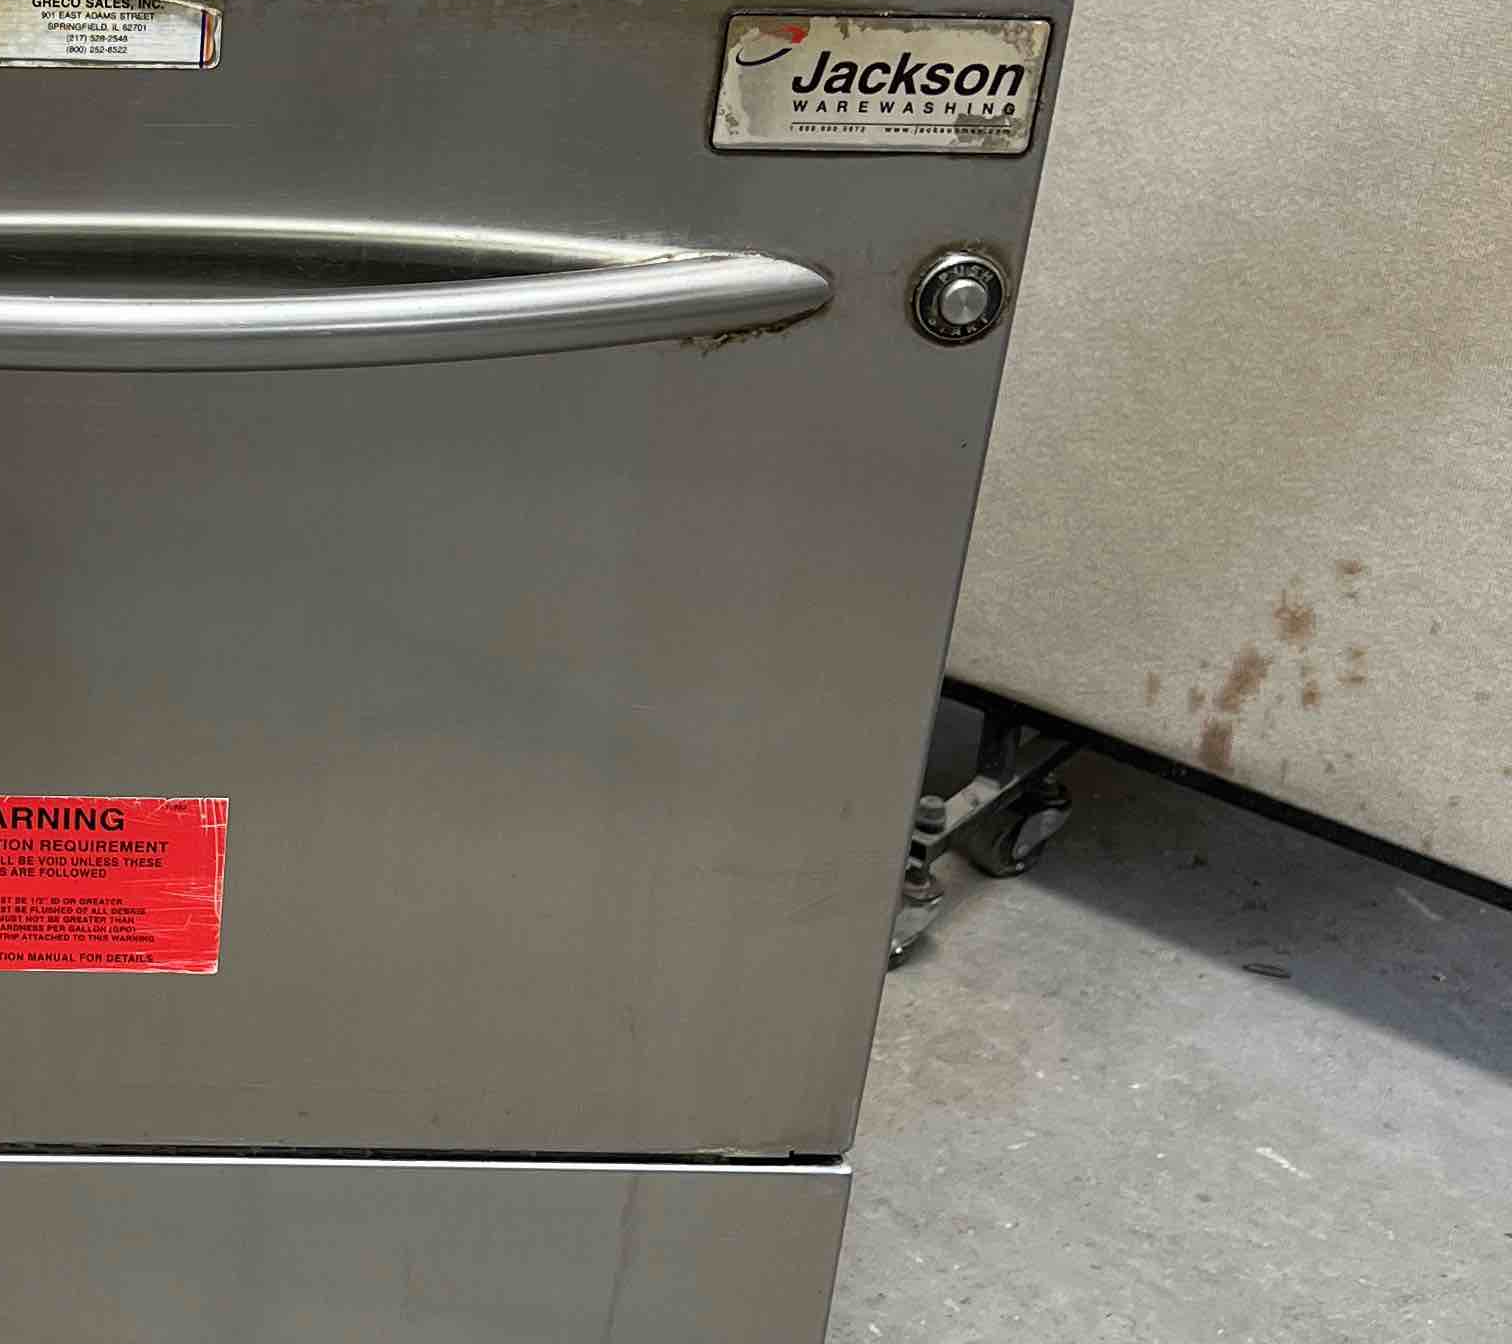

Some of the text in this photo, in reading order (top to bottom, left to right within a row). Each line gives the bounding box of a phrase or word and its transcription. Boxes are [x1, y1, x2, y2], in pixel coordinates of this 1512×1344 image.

[41, 12, 155, 21] 901 EAST ADAMS STREET
[47, 23, 110, 32] SPRINGFIELD,
[791, 50, 1025, 96] Jackson
[792, 100, 1016, 115] WAREWASHING
[938, 264, 994, 284] PUSH
[39, 840, 169, 853] REQUIREMENT
[17, 856, 35, 865] BE
[38, 856, 67, 866] VOID
[71, 857, 120, 867] UNLESS
[123, 858, 163, 868] THESE
[10, 867, 36, 877] ARE
[39, 868, 107, 878] FOLLOWED
[27, 953, 74, 962] MANUAL
[79, 953, 103, 962] FOR
[106, 954, 153, 963] DETAILS
